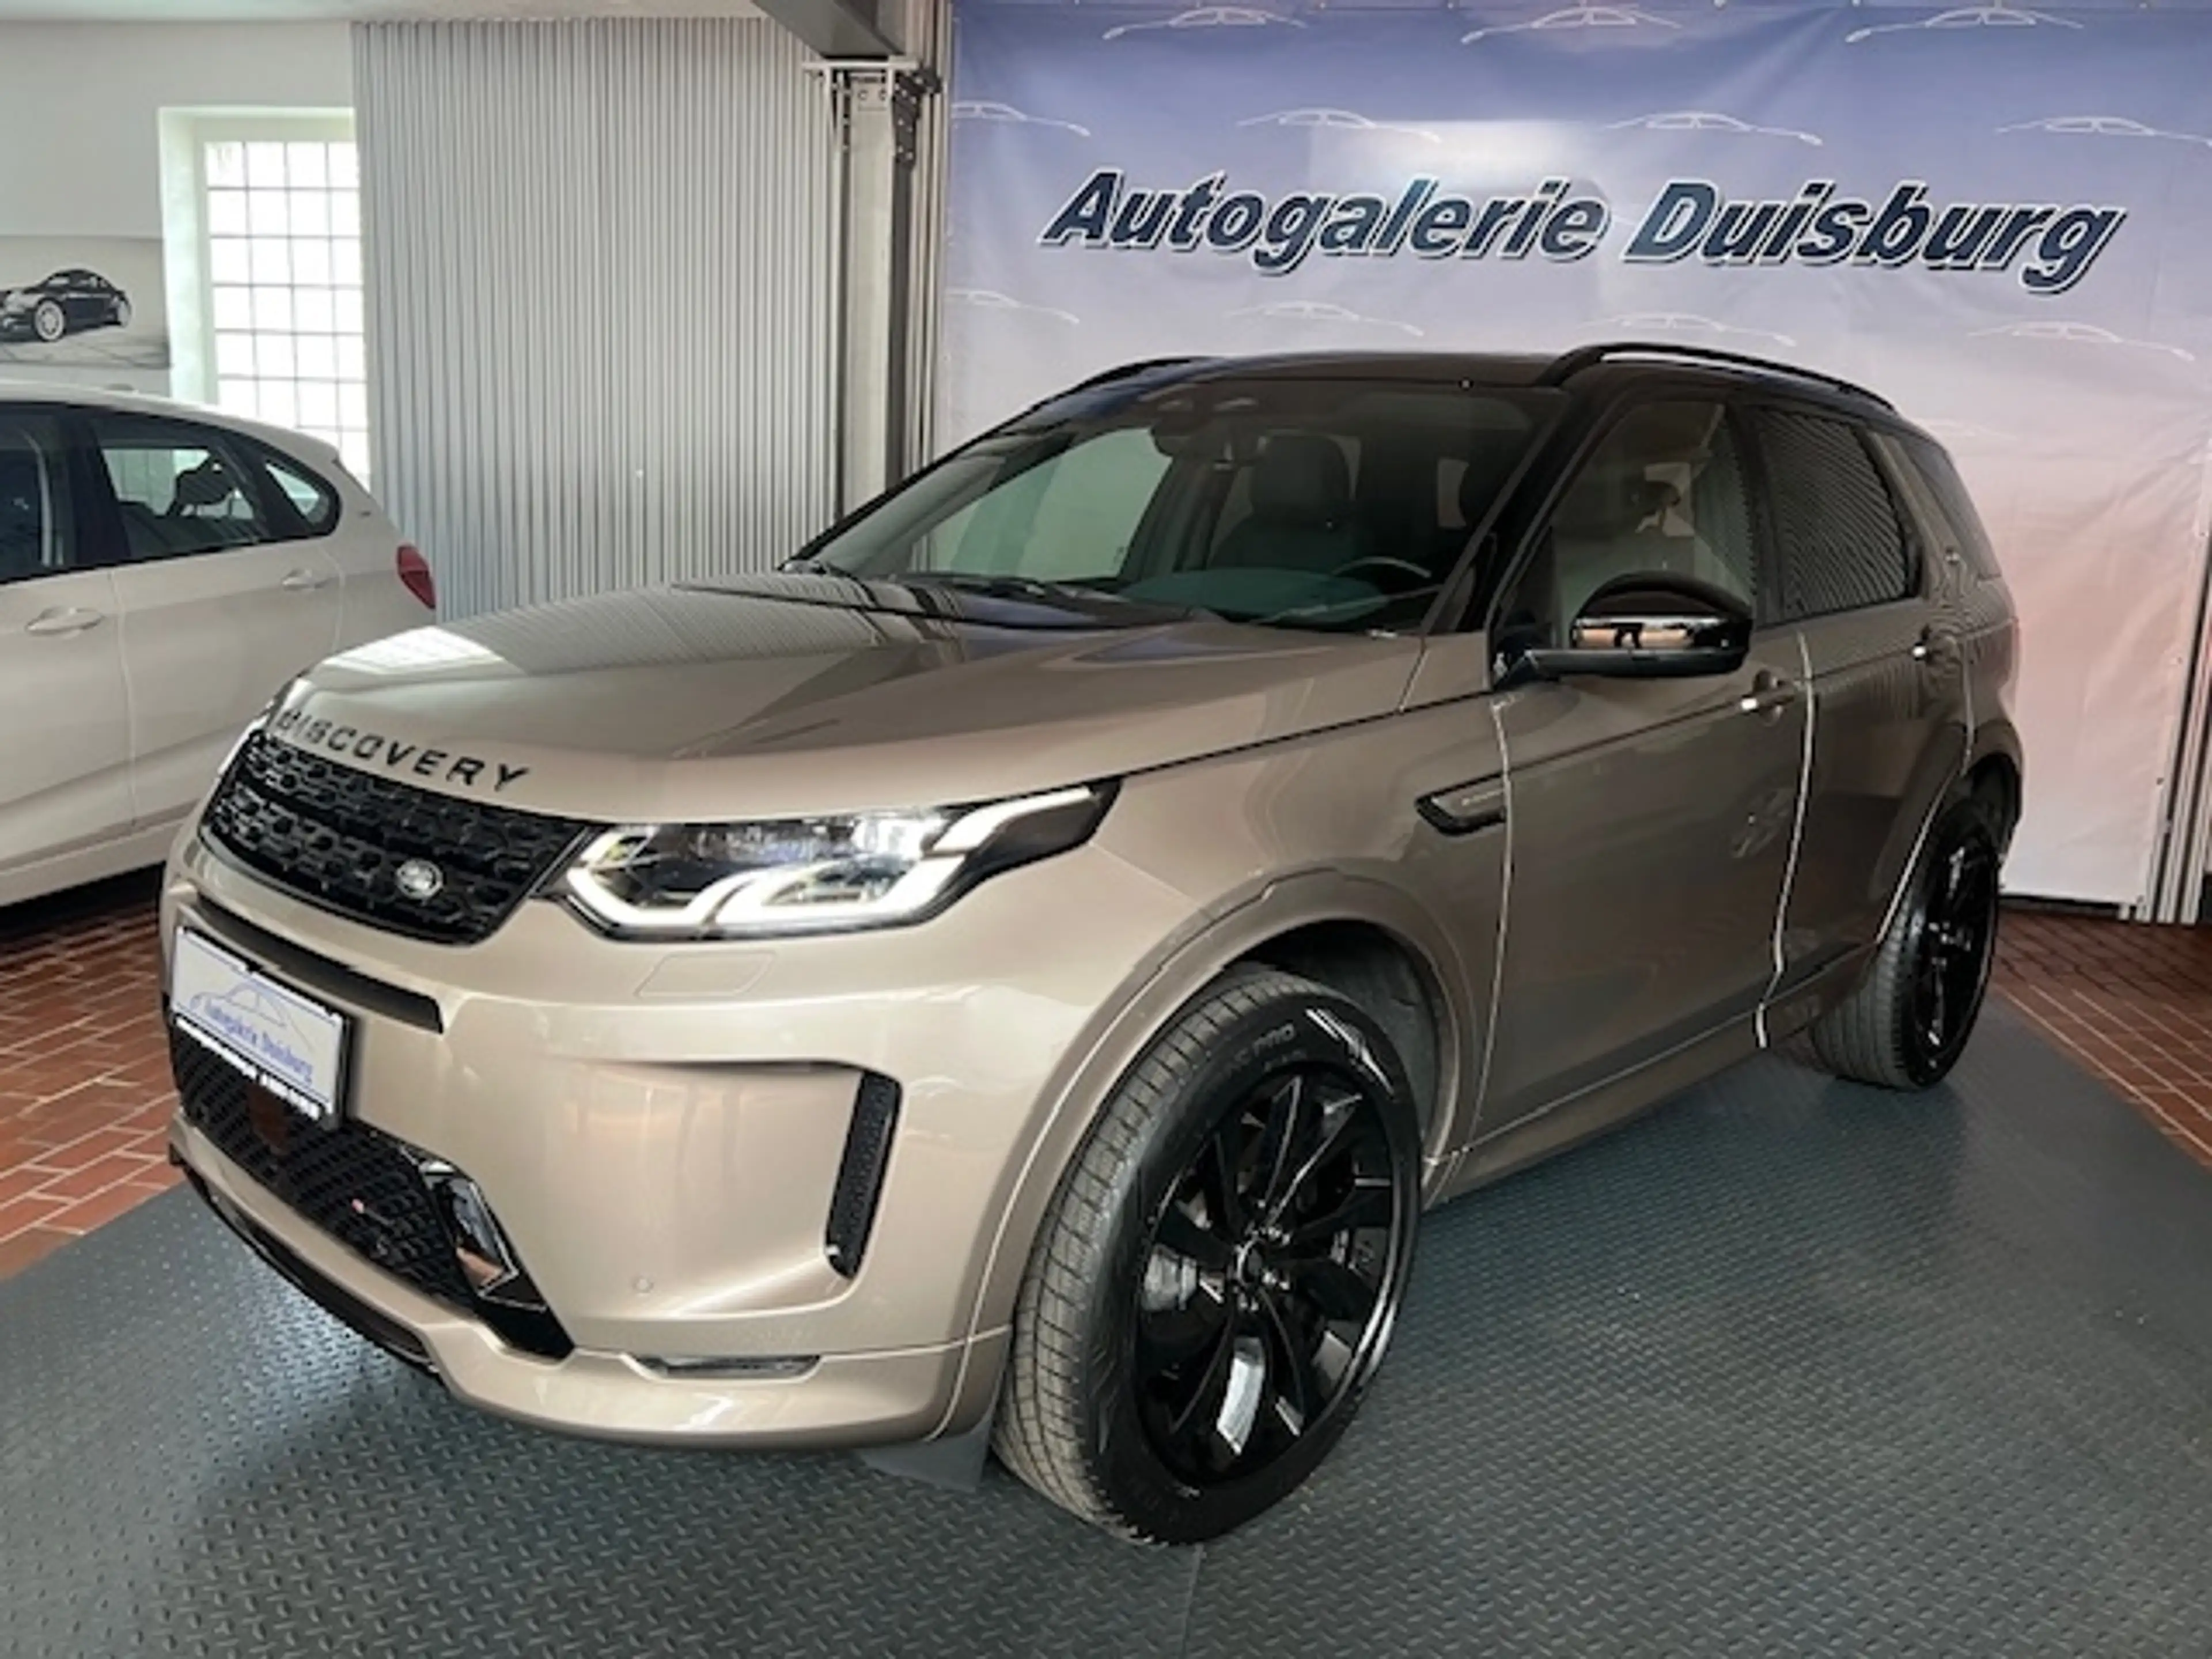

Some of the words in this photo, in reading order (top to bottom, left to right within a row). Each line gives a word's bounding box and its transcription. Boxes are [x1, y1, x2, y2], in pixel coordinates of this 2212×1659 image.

[1037, 168, 1611, 276] Autogalerie
[1622, 180, 2127, 295] Duisburg
[276, 710, 529, 792] DISCOVERY
